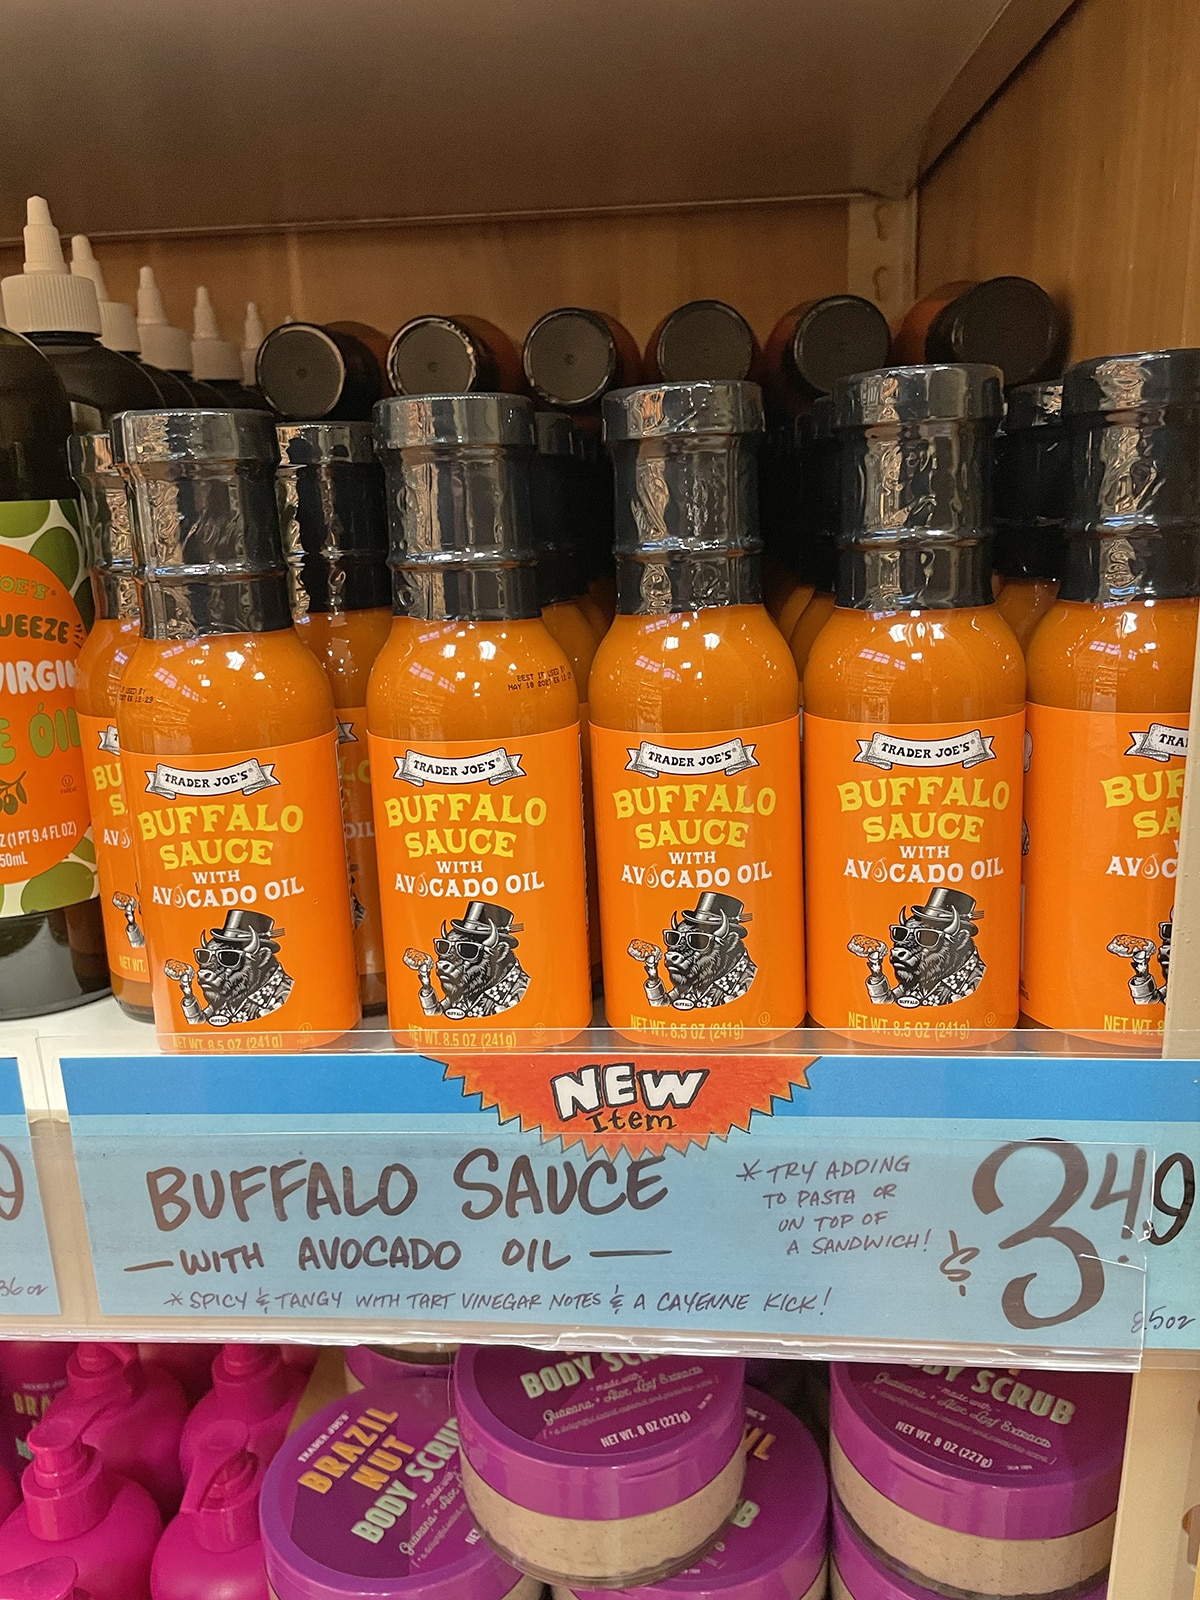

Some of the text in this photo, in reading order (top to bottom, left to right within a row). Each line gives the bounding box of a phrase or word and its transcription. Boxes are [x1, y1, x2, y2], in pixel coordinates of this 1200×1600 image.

[648, 750, 732, 767] TRADER JOE'S
[881, 741, 970, 759] TRADER JOE'S
[164, 771, 249, 788] TRADER JOE'S
[413, 759, 496, 776] TRADER JOE'S
[612, 784, 777, 819] BUFFALO
[836, 776, 1010, 812] BUFFALO
[137, 804, 304, 841] BUFFALO
[384, 793, 547, 828] BUFFALO
[18, 830, 30, 845] PT
[32, 826, 48, 843] 9.4
[49, 824, 61, 839] FL
[61, 821, 77, 837] OZ)
[635, 818, 749, 850] SAUCE
[862, 812, 985, 843] SAUCE
[159, 838, 274, 871] SAUCE
[404, 827, 517, 858] SAUCE
[899, 845, 950, 859] WITH
[436, 860, 483, 874] WITH
[668, 851, 716, 865] WITH
[843, 857, 1004, 883] AVOCADO OIL
[1105, 853, 1178, 879] AVOC
[192, 869, 241, 884] WITH
[394, 871, 545, 897] AVOCADO OIL
[621, 861, 773, 888] AVOCADO OIL
[152, 876, 305, 908] AVOCADO OIL
[119, 956, 132, 969] NET
[408, 1023, 423, 1041] NET
[424, 1029, 441, 1045] WT.
[443, 1032, 459, 1047] 8.5
[462, 1033, 476, 1047] OZ
[481, 1031, 517, 1051] (241g)
[630, 1014, 744, 1042] NET WT. 8.5 OZ (241g)
[848, 1011, 970, 1042] NET WT. 8.5 OZ (241g)
[1104, 1014, 1129, 1033] NET
[1131, 1018, 1154, 1036] WT.
[172, 1034, 188, 1048] NET
[188, 1036, 204, 1049] WT.
[207, 1037, 223, 1050] 8.5
[227, 1036, 241, 1049] OZ
[246, 1034, 283, 1050] (241g)
[550, 1062, 710, 1121] NEW
[585, 1108, 677, 1133] Item
[766, 1155, 911, 1184] TRY ADDING
[146, 1148, 669, 1232] BUFFALO SAUCE
[763, 1183, 897, 1209] TO PASTA OR
[778, 1211, 888, 1232] ON TOP OF
[179, 1235, 571, 1276] WITH AVOCADO OIL
[786, 1228, 931, 1256] A SANDWICH!
[190, 1291, 248, 1309] SPICY
[274, 1291, 343, 1310] TANGY
[356, 1294, 400, 1308] WITH
[407, 1292, 455, 1310] TART
[462, 1292, 542, 1310] VINEGAR
[549, 1292, 602, 1311] NOTES
[633, 1293, 646, 1310] A
[657, 1291, 750, 1313] CAYENNE
[763, 1287, 832, 1316] KICK!
[520, 1355, 596, 1399] BODY
[971, 1370, 1076, 1425] SCRUB
[600, 1431, 619, 1448] NET
[619, 1427, 638, 1442] WT.
[638, 1424, 646, 1435] 8
[646, 1420, 660, 1433] OZ
[895, 1421, 916, 1436] NET
[916, 1429, 931, 1444] WT.
[933, 1436, 941, 1447] 8
[942, 1440, 958, 1453] OZ
[958, 1447, 993, 1468] (227g)
[297, 1407, 399, 1495] BRAZIL
[350, 1434, 416, 1491] NUT
[350, 1416, 460, 1544] BODY SCRU
